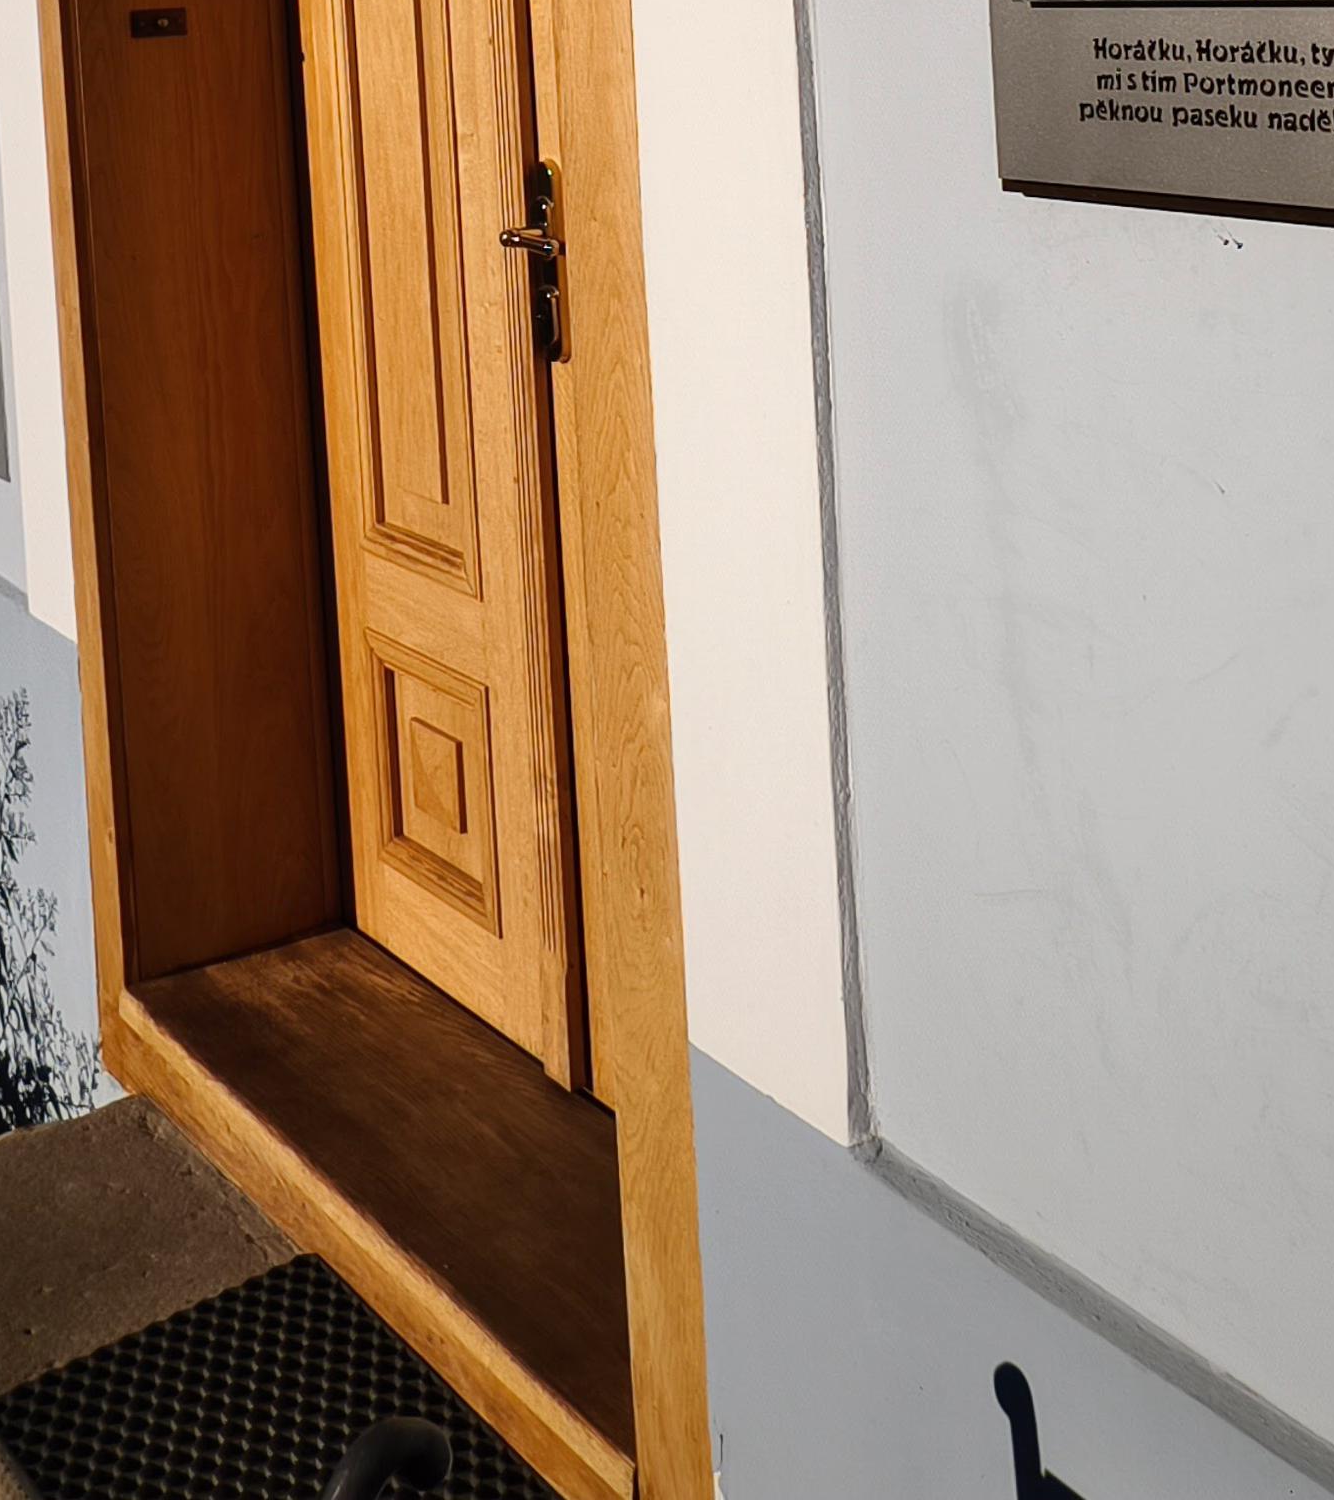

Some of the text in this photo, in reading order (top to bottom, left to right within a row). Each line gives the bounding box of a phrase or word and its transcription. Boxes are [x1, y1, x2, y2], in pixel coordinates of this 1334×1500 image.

[1092, 37, 1192, 64] Horáčku,
[1195, 38, 1306, 67] Horáčku,
[1096, 67, 1122, 91] mi
[1126, 72, 1138, 91] s
[1141, 70, 1177, 93] tím
[1078, 98, 1164, 124] pěknou
[1172, 104, 1258, 129] paseku
